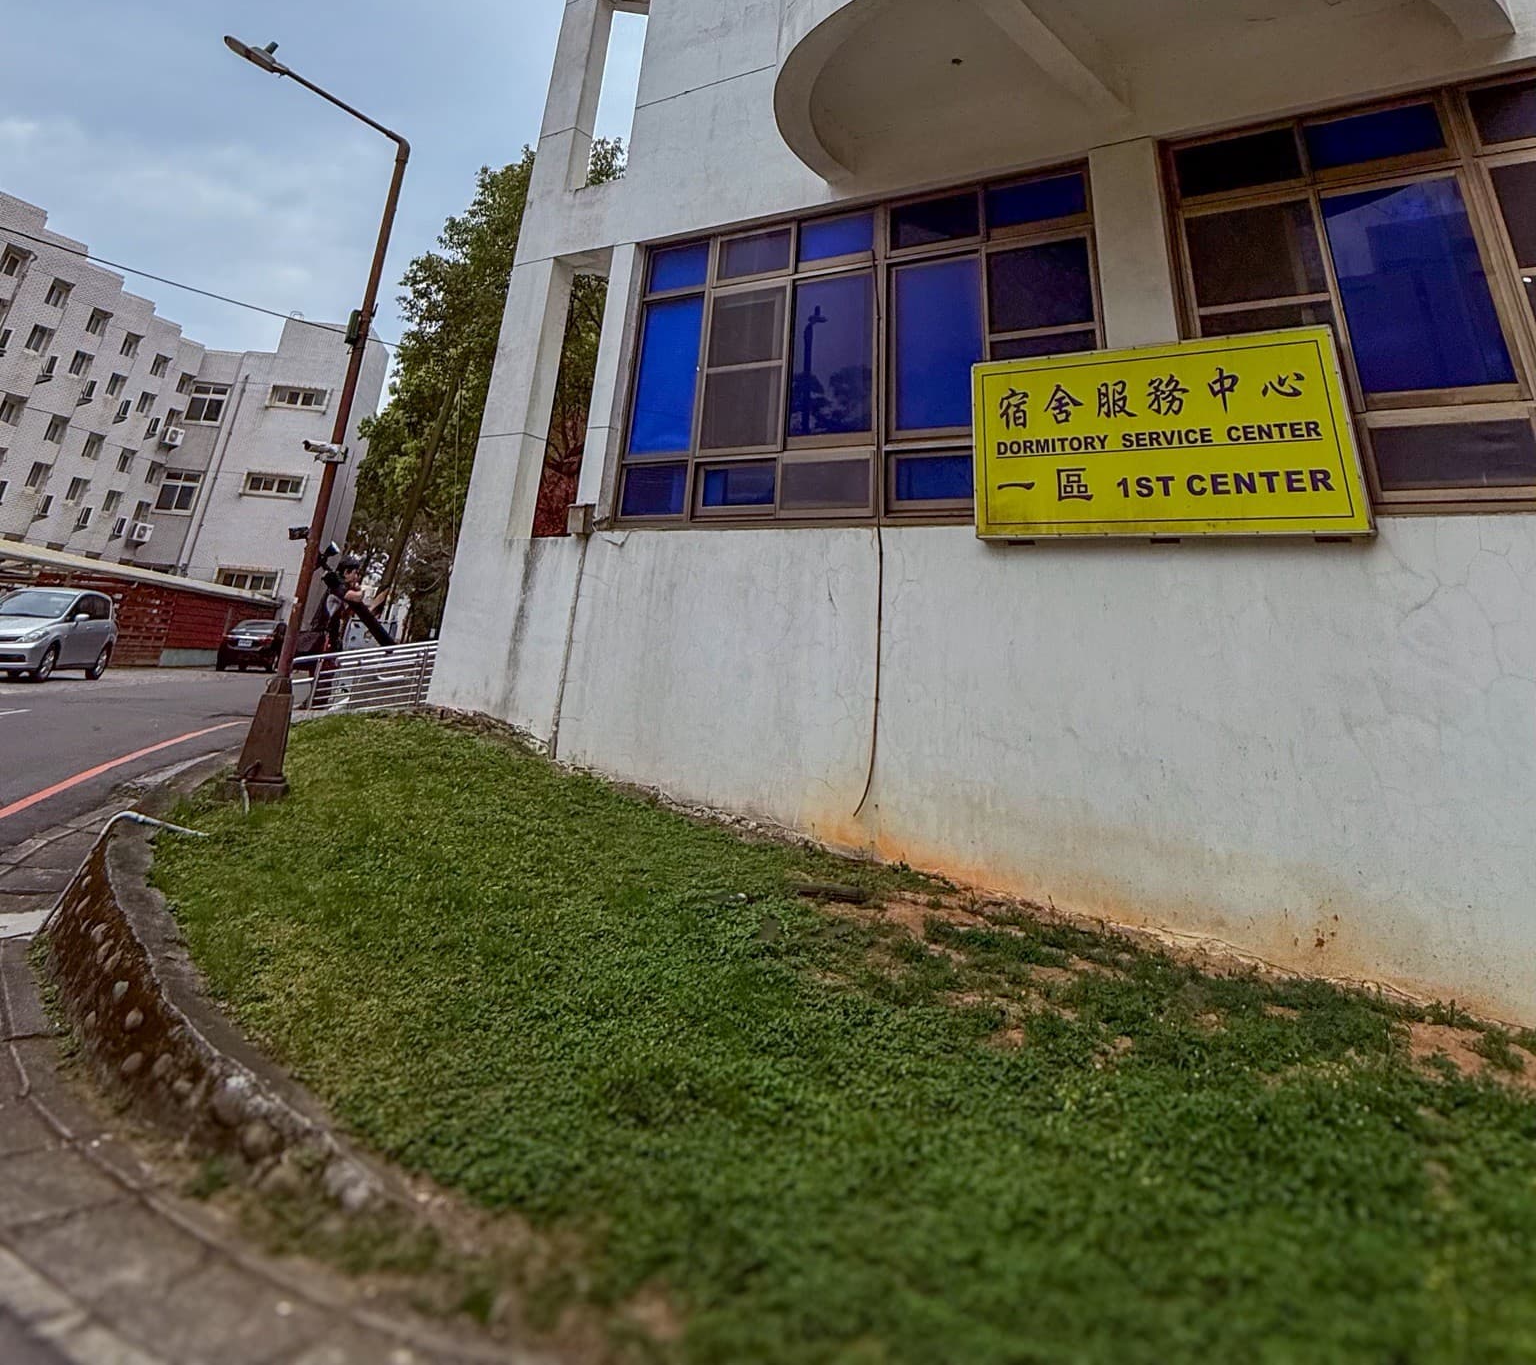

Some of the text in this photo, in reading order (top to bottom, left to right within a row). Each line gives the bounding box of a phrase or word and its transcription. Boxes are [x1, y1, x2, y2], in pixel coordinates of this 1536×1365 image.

[999, 366, 1305, 431] 宿舍服務中心
[996, 420, 1323, 456] DORMITORY SERVICE CENTER
[997, 467, 1336, 502] 一區 1ST CENTER
